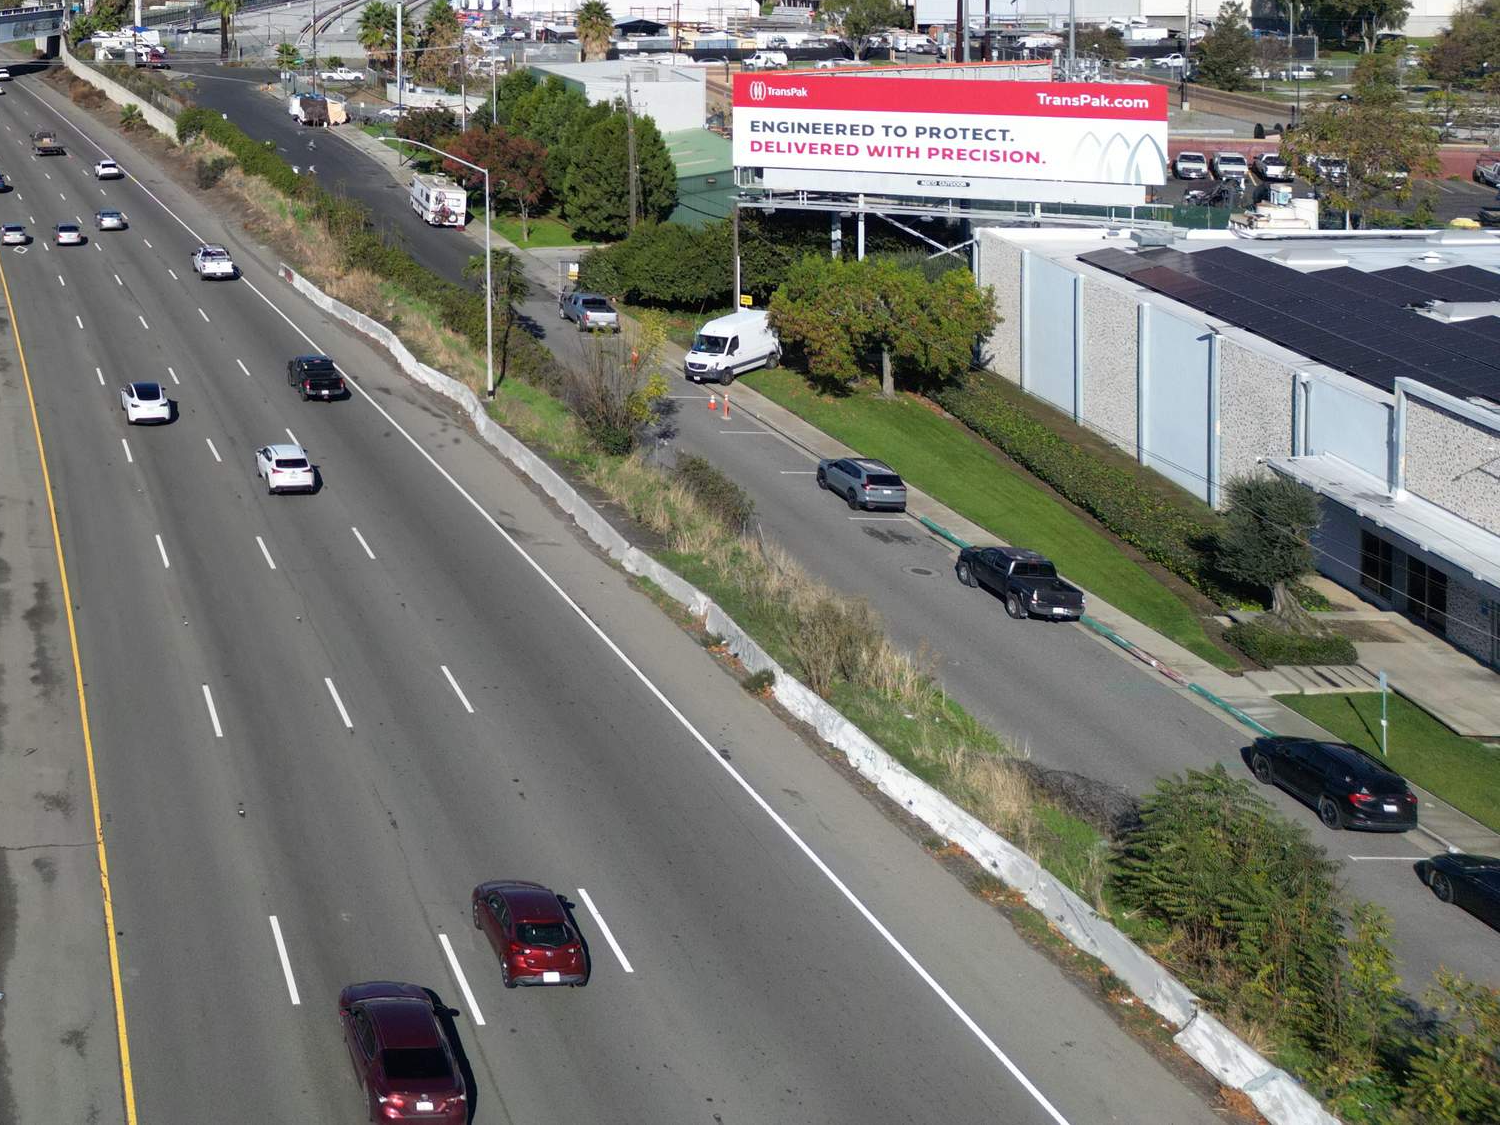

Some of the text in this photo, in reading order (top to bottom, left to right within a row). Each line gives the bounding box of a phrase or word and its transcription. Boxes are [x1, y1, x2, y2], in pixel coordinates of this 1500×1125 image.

[767, 87, 808, 97] TransPak
[1036, 92, 1149, 109] TransPak.com
[750, 120, 1014, 142] ENGINEERED TO PROTECT.
[750, 140, 1046, 164] DELIVERED WITH PRECISION.
